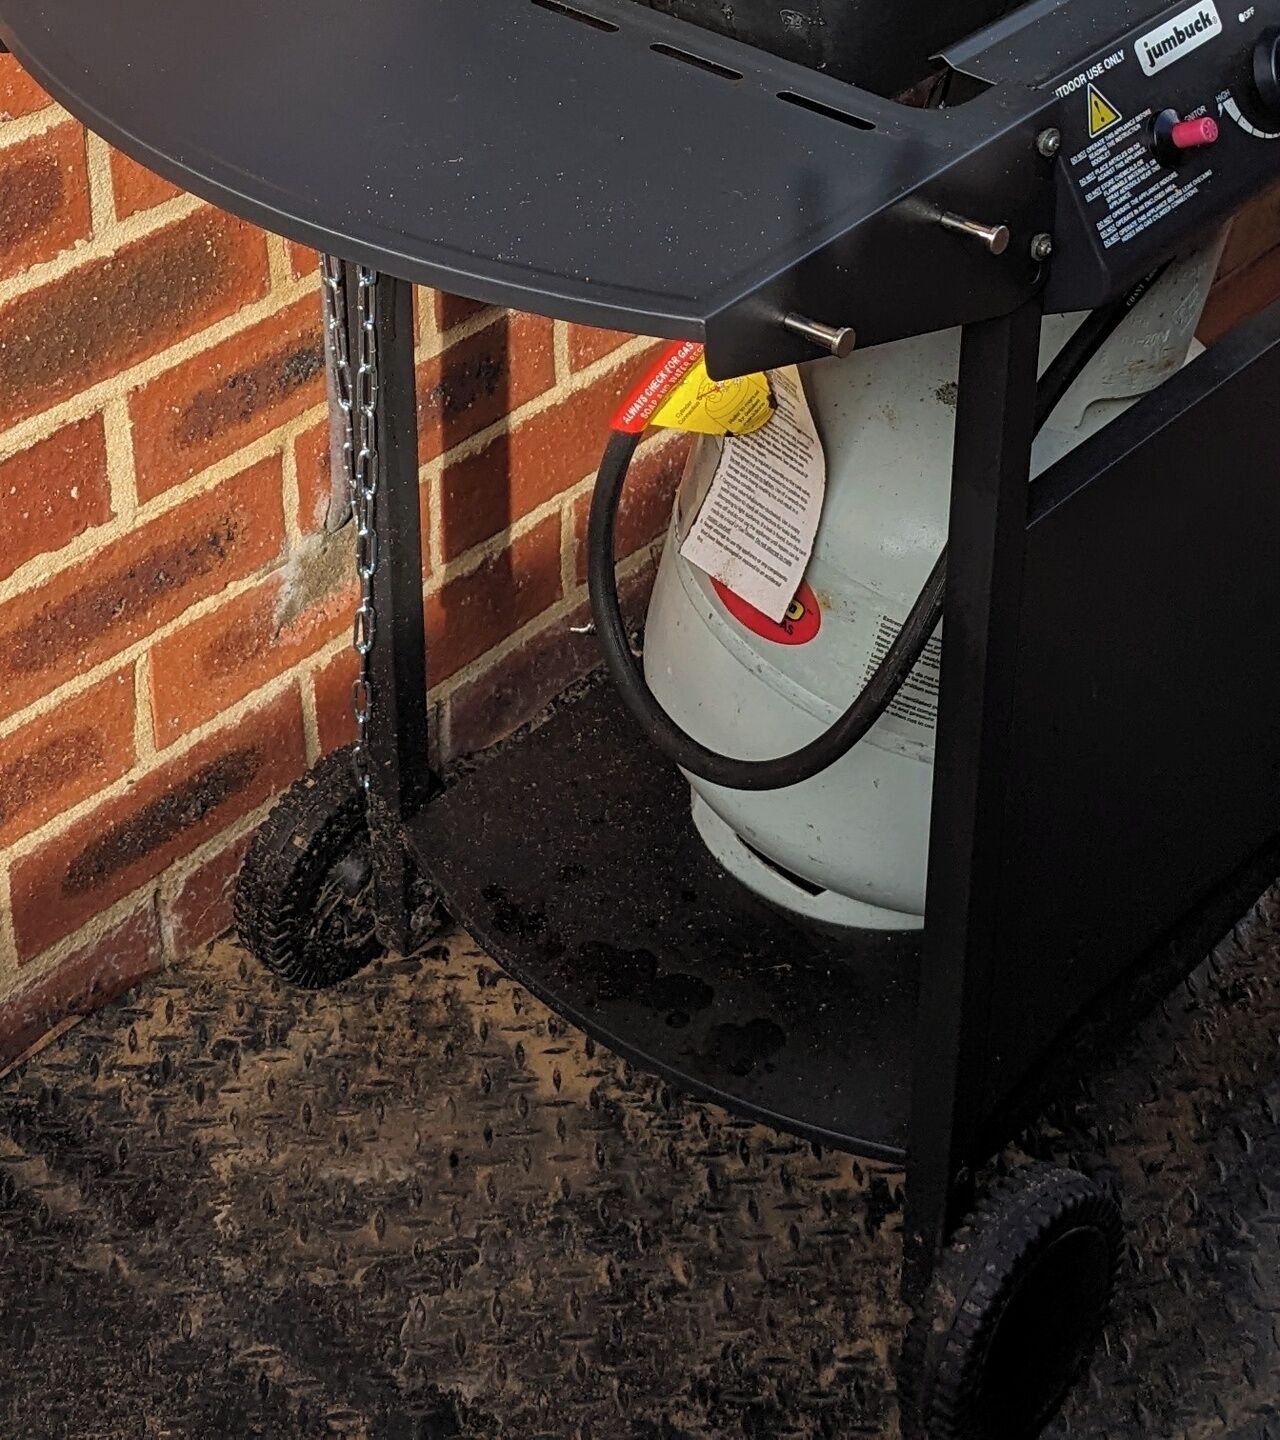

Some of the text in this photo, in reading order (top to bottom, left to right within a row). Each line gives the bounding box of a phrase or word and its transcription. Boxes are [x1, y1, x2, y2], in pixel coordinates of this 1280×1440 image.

[1244, 7, 1255, 19] OFF
[1143, 11, 1213, 68] jumbuck
[1086, 62, 1105, 81] USE
[1104, 49, 1125, 70] ONLY
[1215, 89, 1231, 103] HIGH
[1184, 105, 1208, 121] GNITOR
[622, 341, 694, 424] ALWAYS CHECK FOR GAS
[639, 399, 658, 419] SOAP
